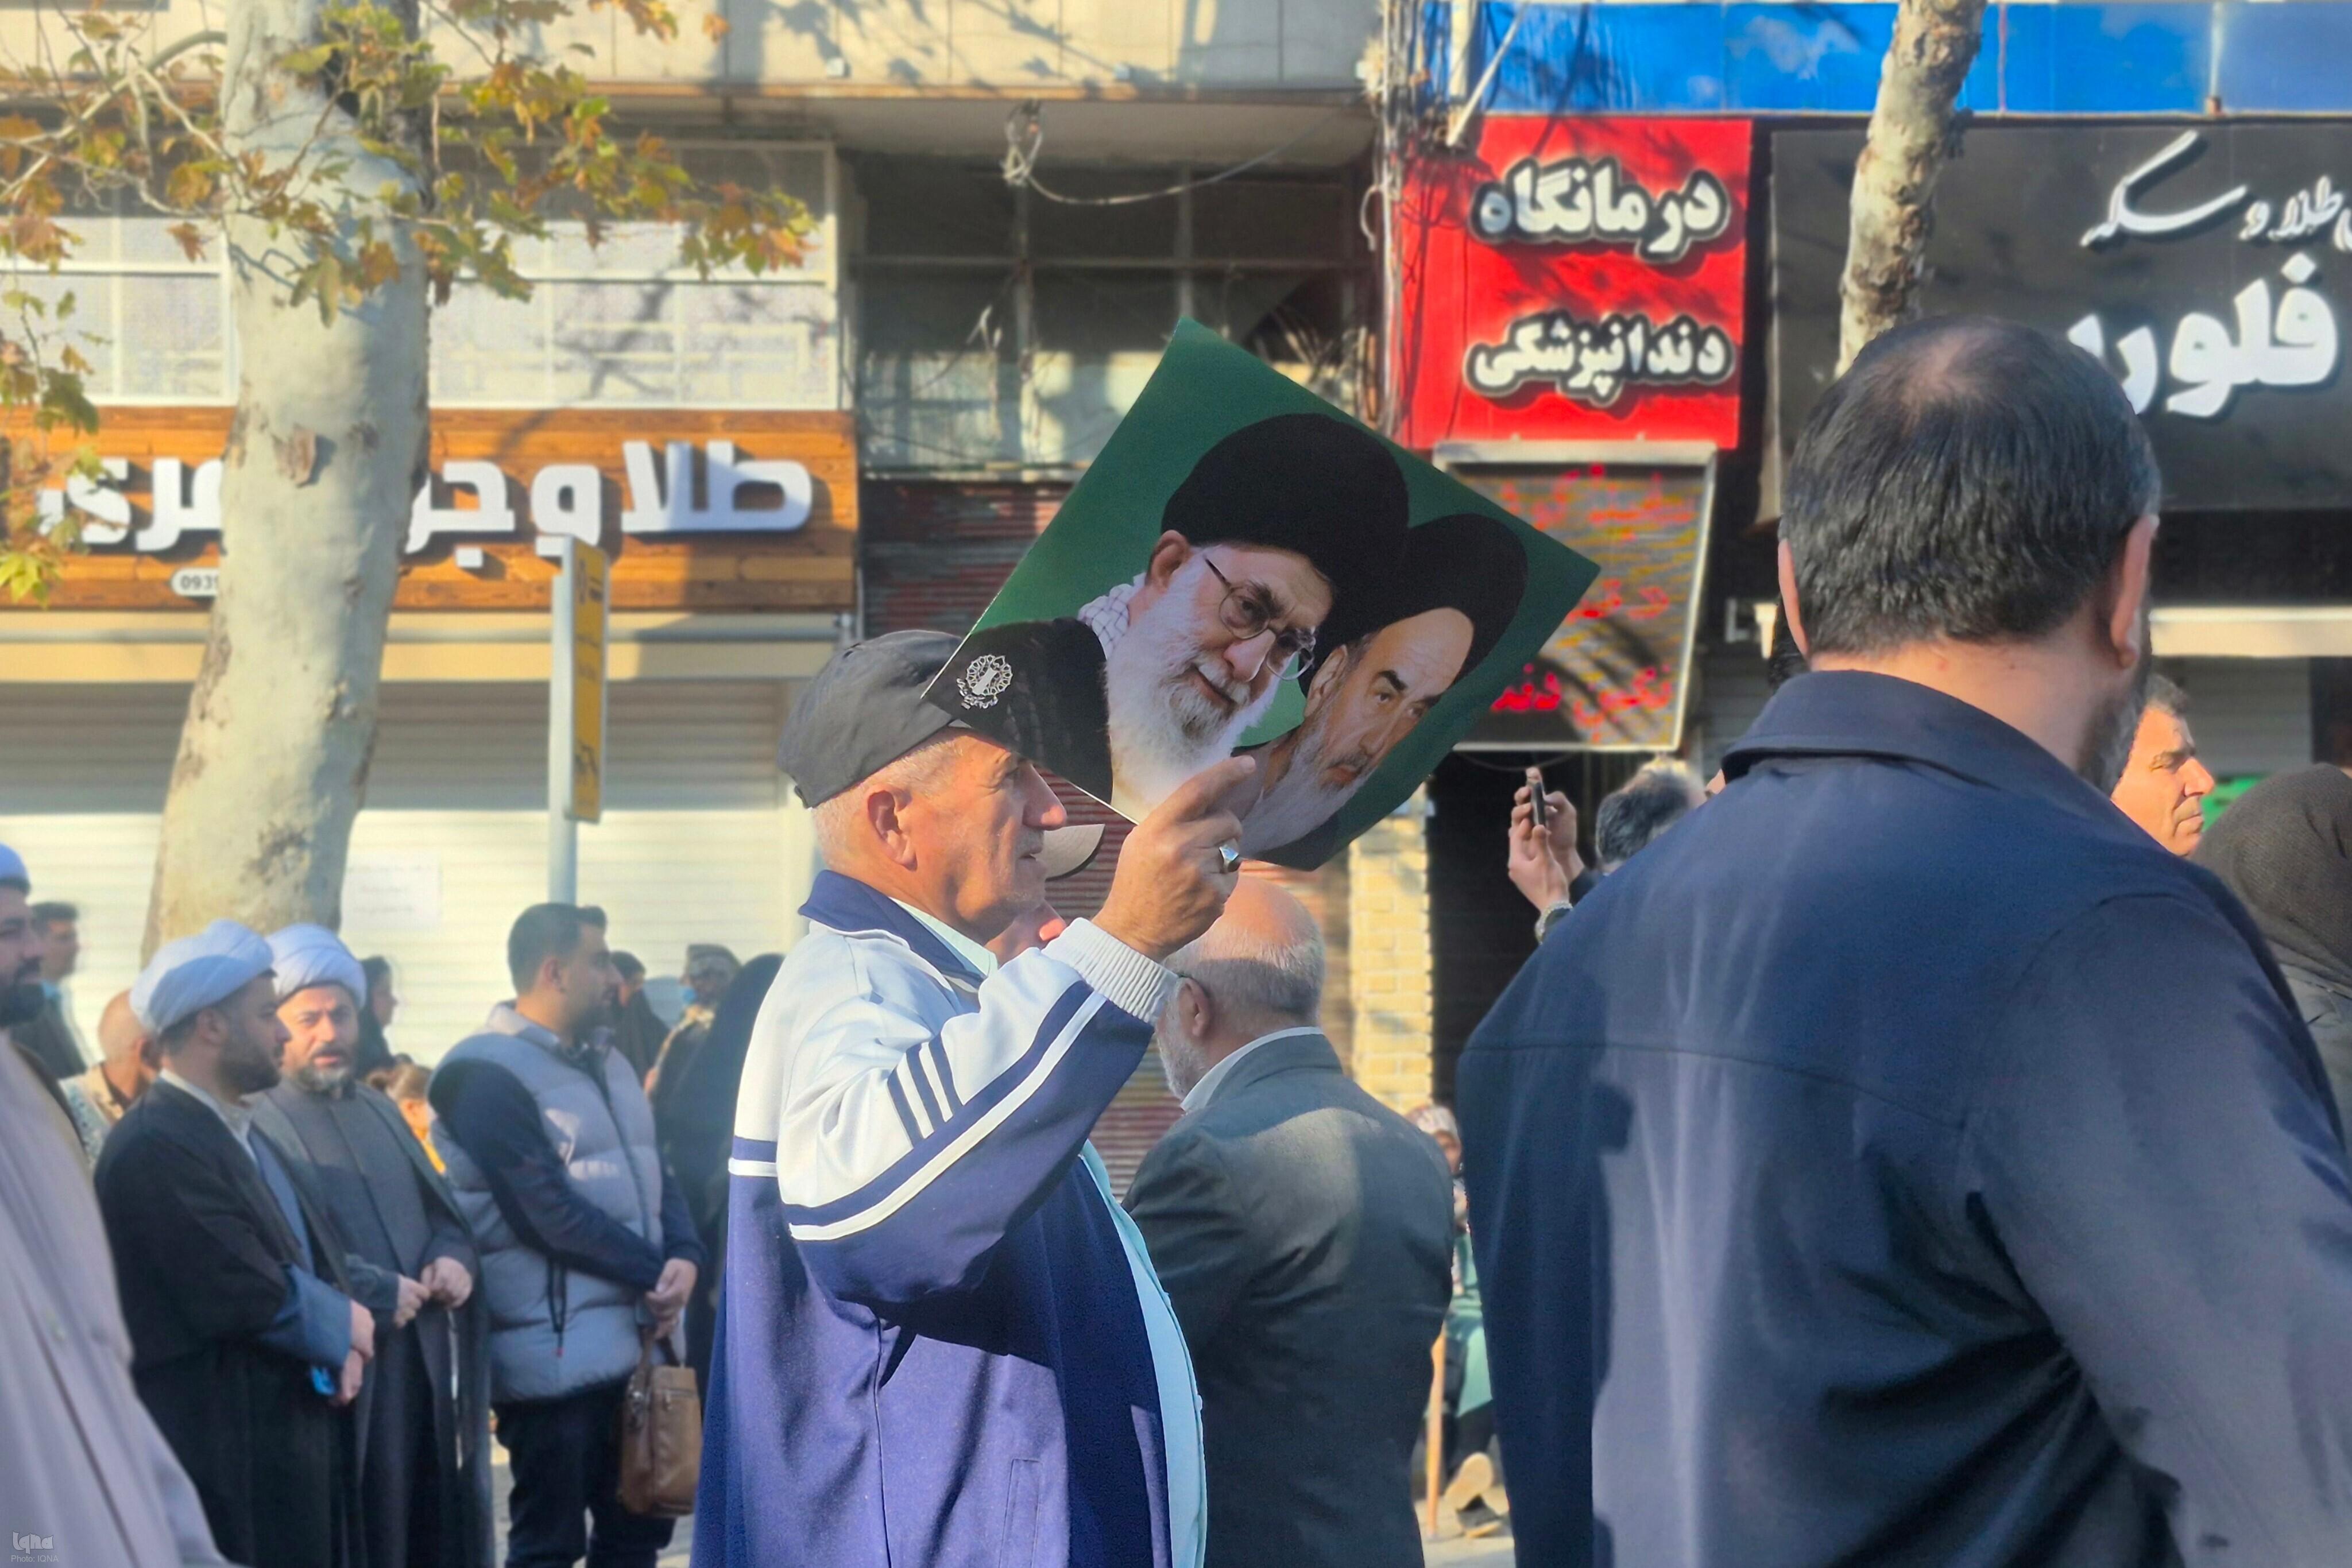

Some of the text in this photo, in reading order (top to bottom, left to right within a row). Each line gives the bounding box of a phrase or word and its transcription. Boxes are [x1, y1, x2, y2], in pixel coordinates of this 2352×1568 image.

[1477, 162, 1723, 255] درمانگاه
[2239, 200, 2271, 241] و
[1470, 316, 1728, 398] دندانپزشکی
[531, 463, 602, 557] و
[620, 440, 813, 533] طلا
